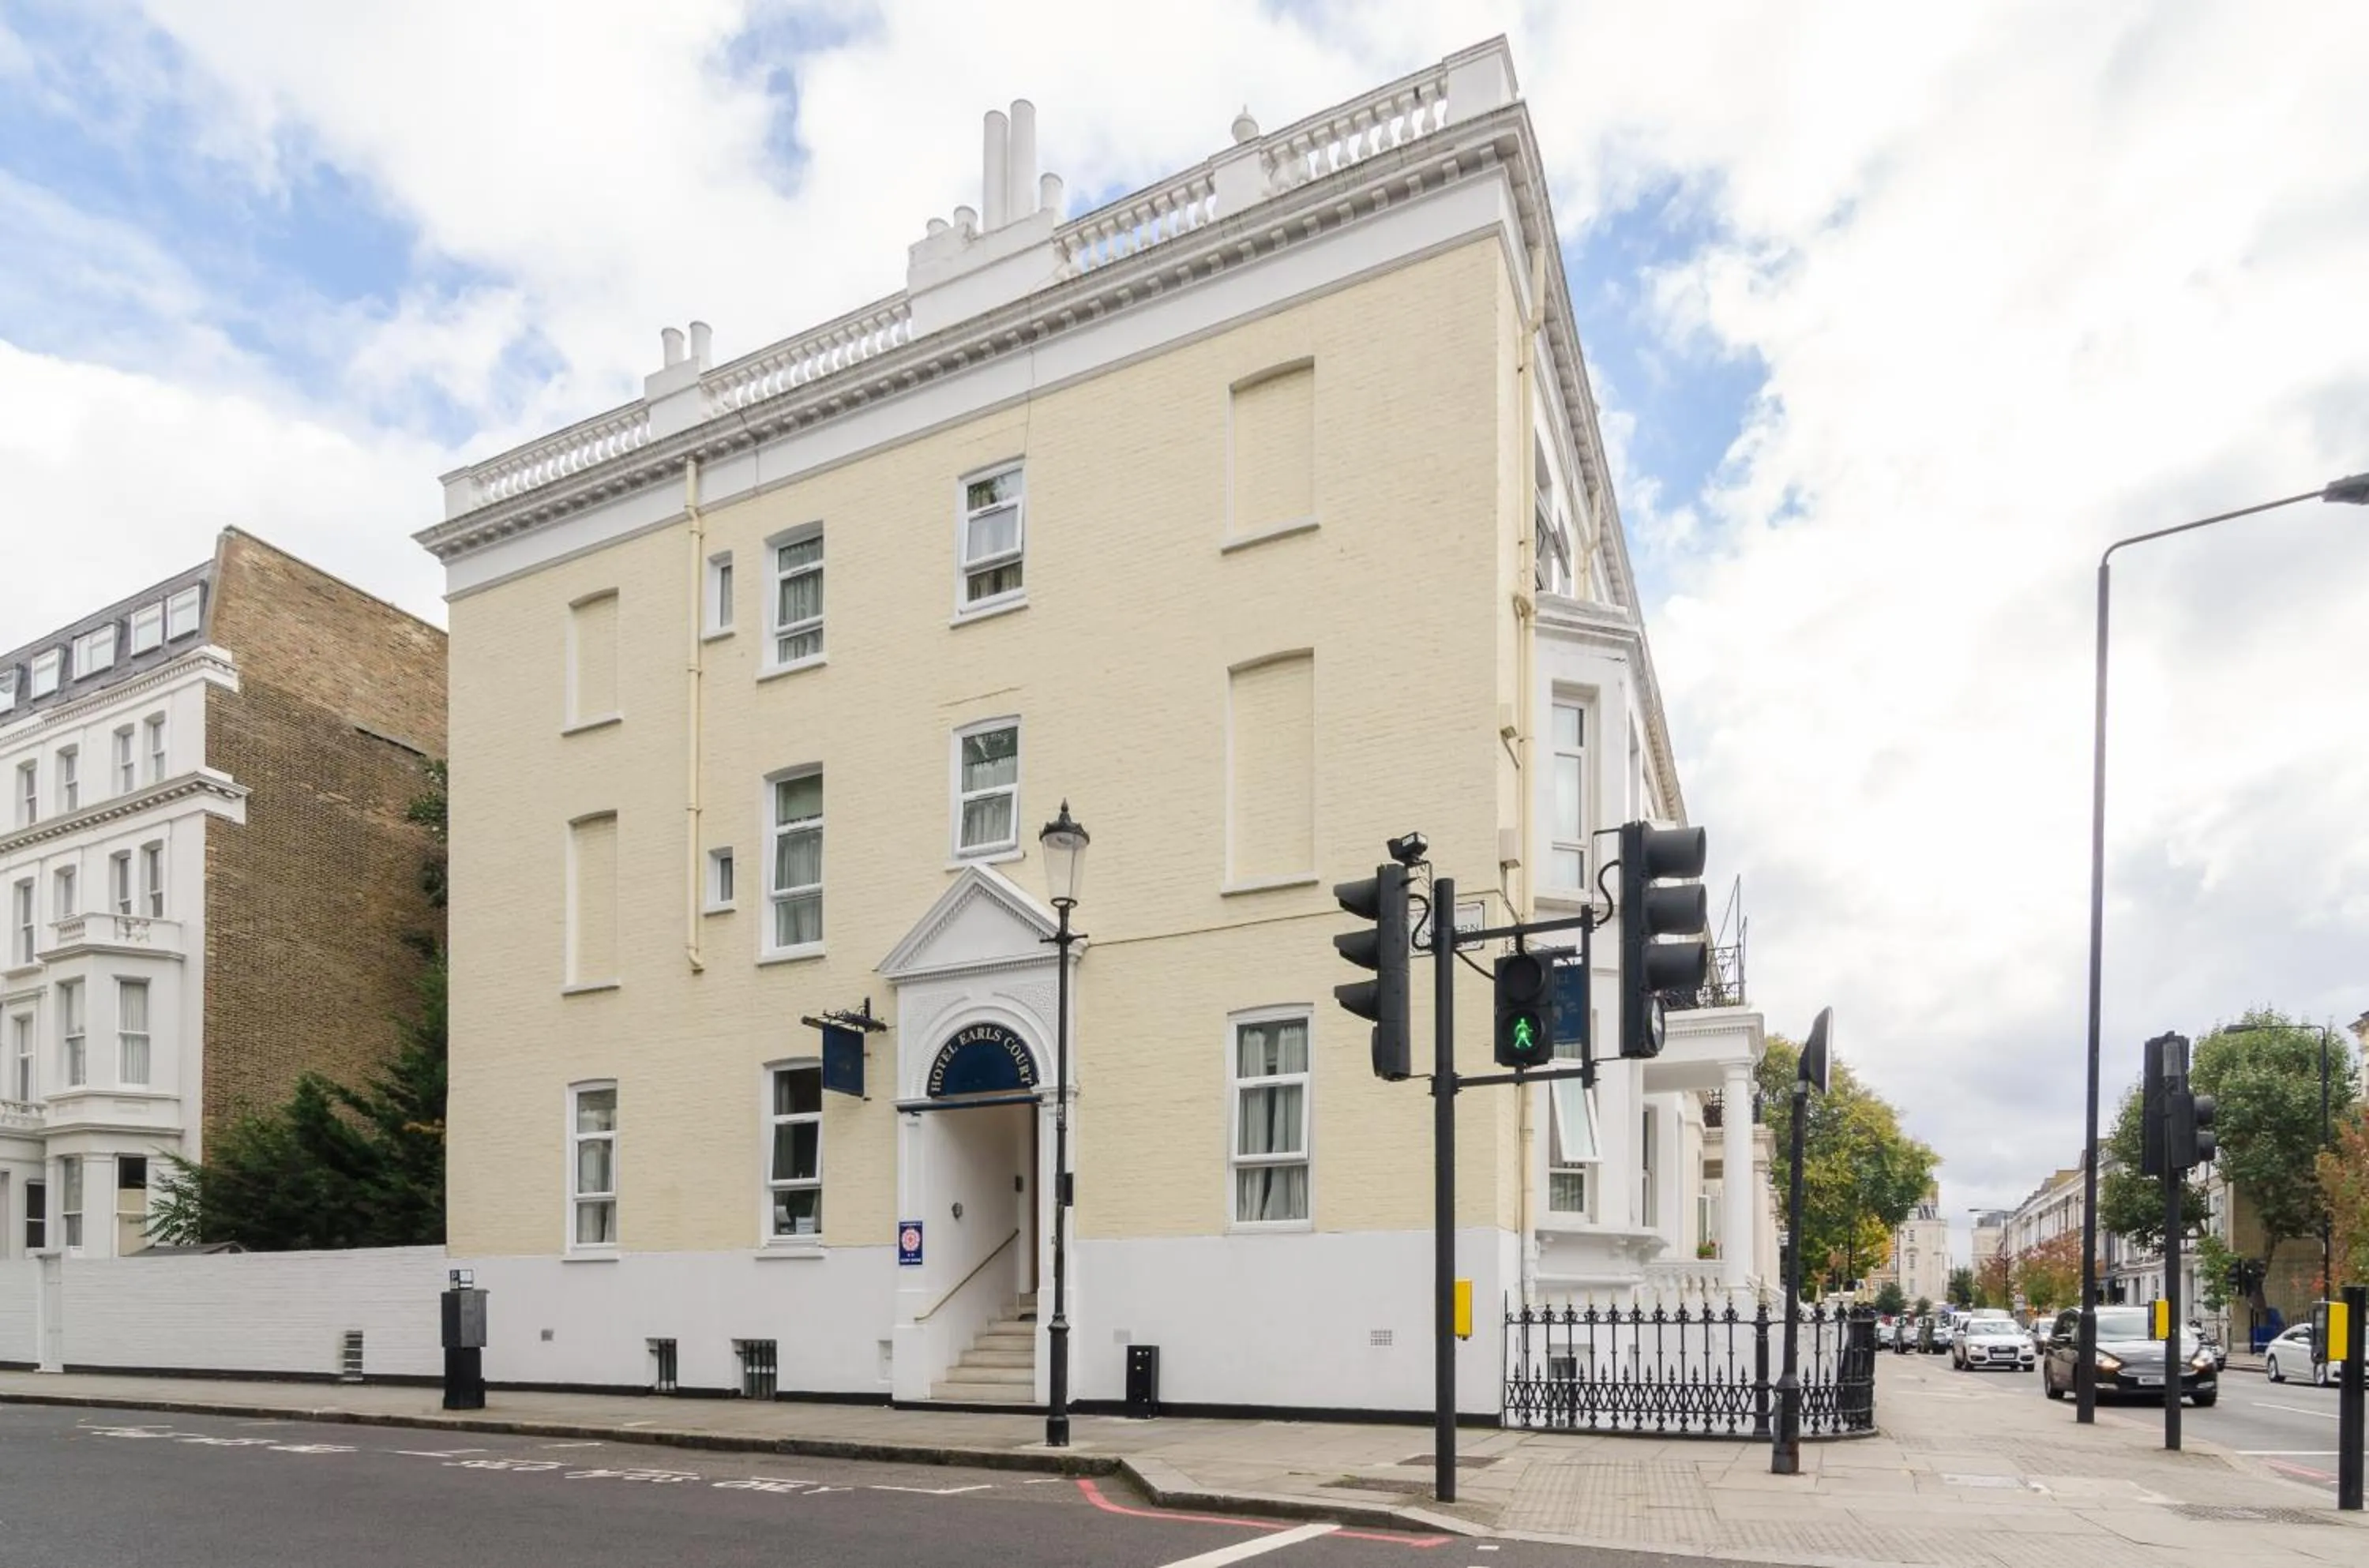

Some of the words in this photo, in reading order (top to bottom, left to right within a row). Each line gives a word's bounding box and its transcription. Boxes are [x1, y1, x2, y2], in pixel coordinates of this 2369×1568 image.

[931, 1044, 958, 1091] HOTEL
[959, 1027, 1002, 1045] EARLS
[1004, 1037, 1033, 1085] COURT
